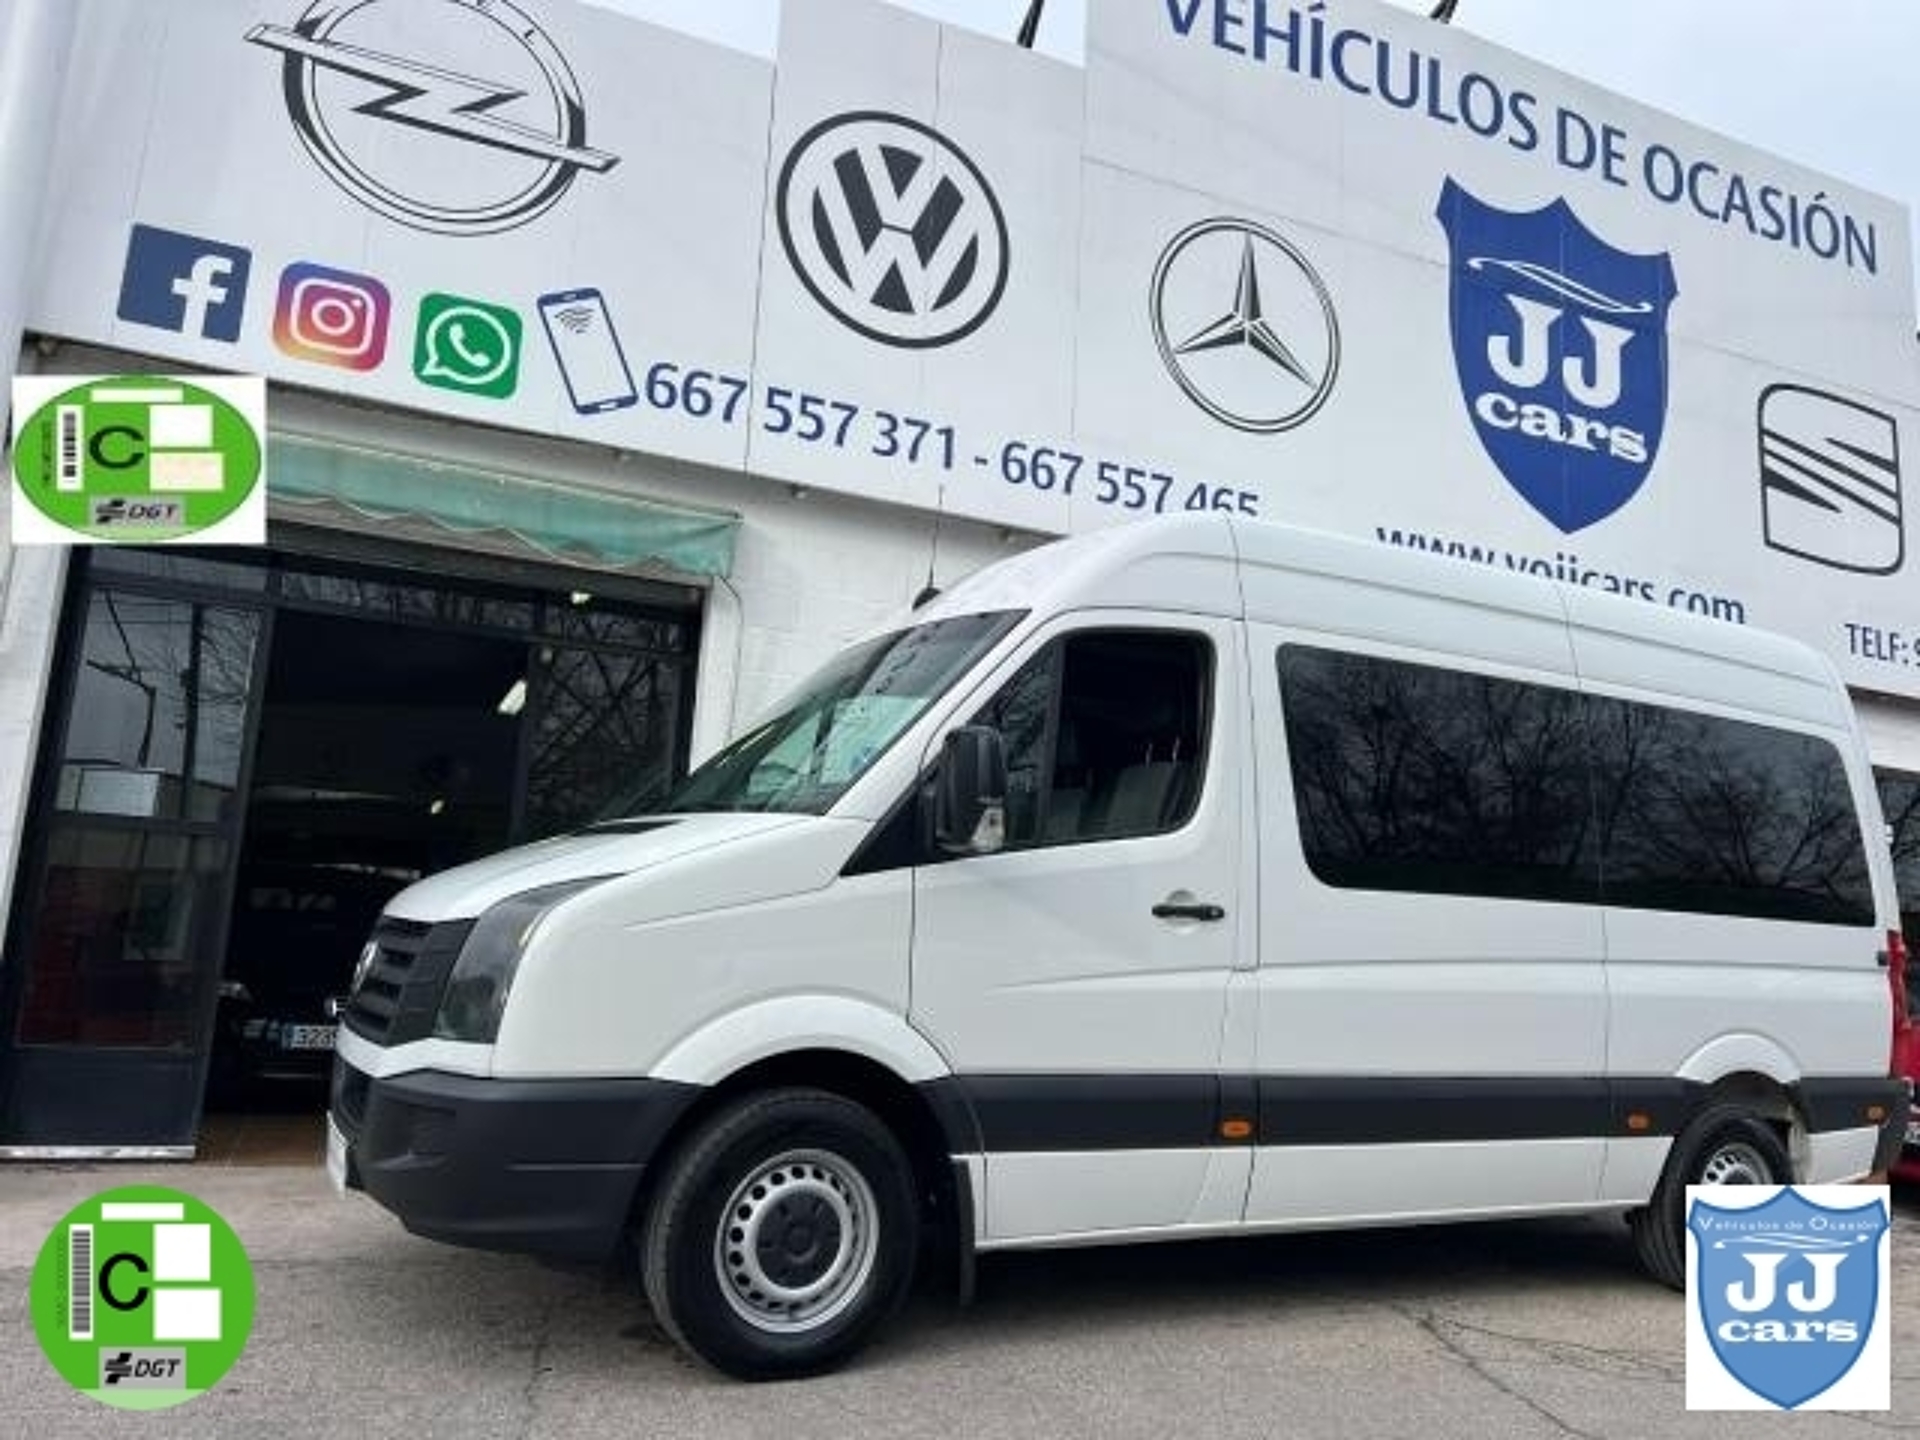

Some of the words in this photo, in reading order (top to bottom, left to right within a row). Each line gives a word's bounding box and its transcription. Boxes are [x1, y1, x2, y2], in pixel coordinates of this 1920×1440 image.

[1166, 0, 1540, 152] VEHÍCULOS
[1556, 107, 1629, 187] DE
[1643, 143, 1877, 276] OCASIÓN
[1487, 293, 1636, 409] JJ
[645, 362, 748, 423] 667
[763, 386, 859, 448] 557
[872, 410, 956, 470] 371
[1001, 440, 1084, 496] 667
[1096, 461, 1174, 514] 557
[1475, 392, 1648, 463] cars
